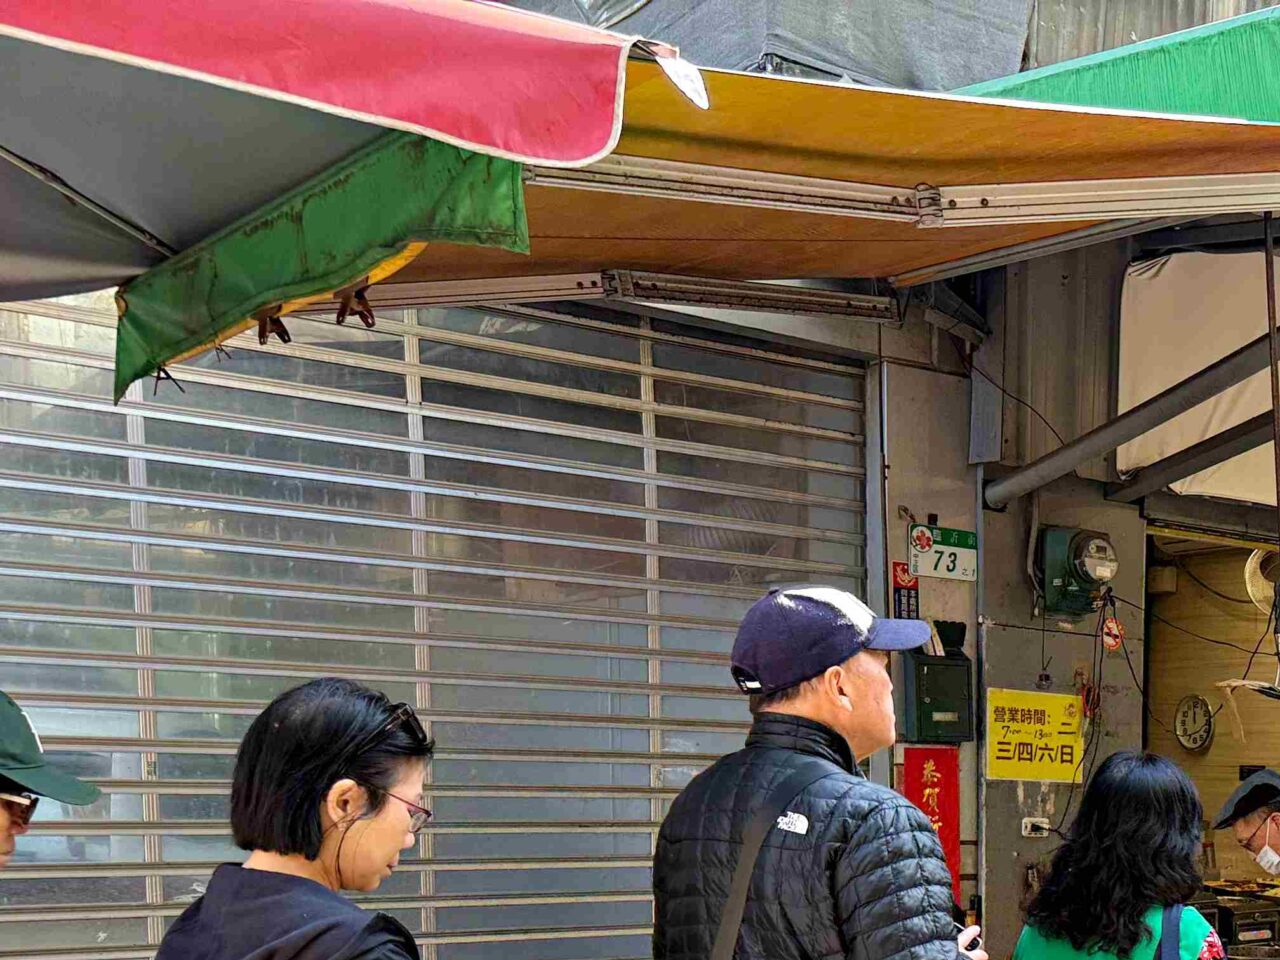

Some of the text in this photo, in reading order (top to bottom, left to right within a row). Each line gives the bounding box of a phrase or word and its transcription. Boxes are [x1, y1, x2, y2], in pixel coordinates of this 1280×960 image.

[933, 550, 958, 573] 73
[751, 735, 777, 746] FILA
[995, 741, 1074, 765] 三/四/六/日
